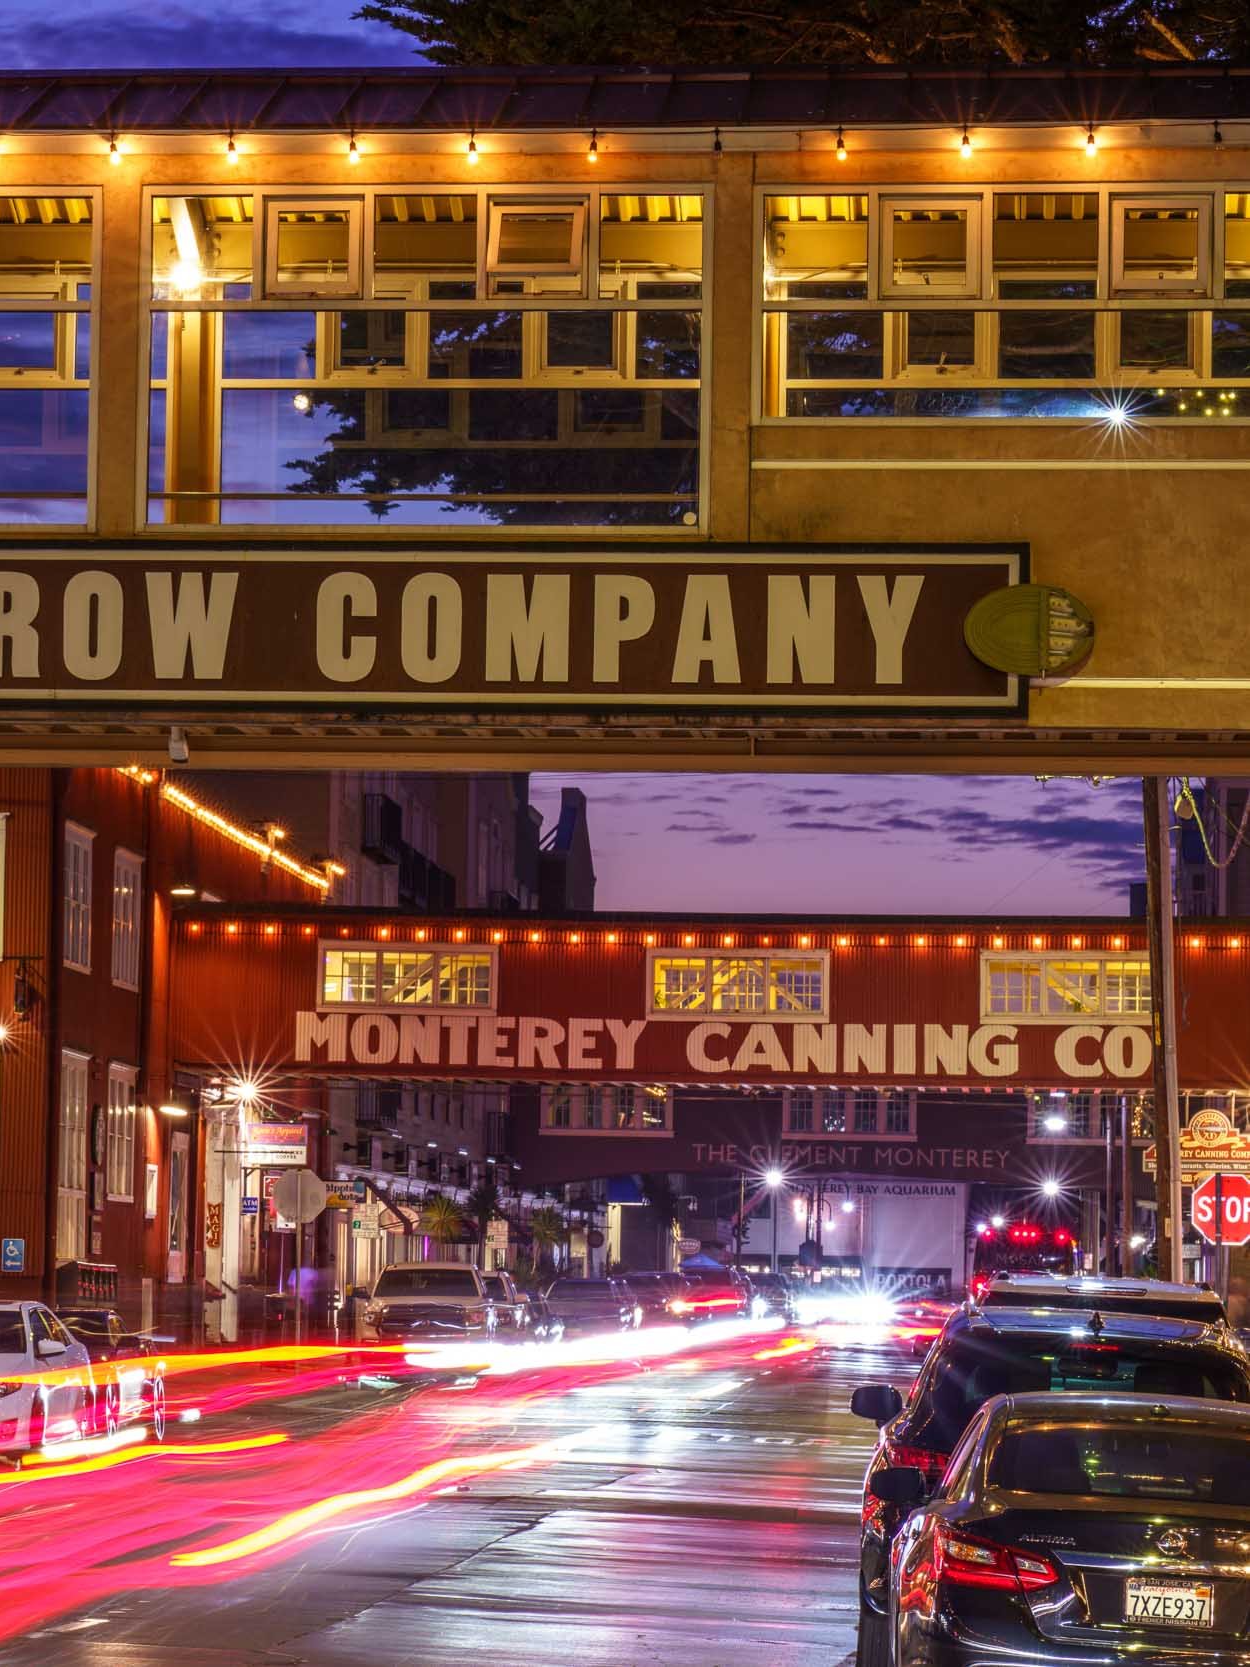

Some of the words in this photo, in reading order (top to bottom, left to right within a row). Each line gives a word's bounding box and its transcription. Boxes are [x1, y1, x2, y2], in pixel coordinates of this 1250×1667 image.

[317, 571, 925, 686] COMPANY
[295, 1011, 648, 1070] MONTEREY
[686, 1023, 1020, 1077] CANNING
[1054, 1025, 1152, 1078] CO
[692, 1144, 738, 1164] THE
[751, 1145, 863, 1166] CLEMENT
[875, 1148, 1010, 1169] MONTEREY
[1195, 1149, 1229, 1158] CANNING
[856, 1184, 879, 1195] BAY
[883, 1185, 956, 1196] AQUARIUM
[243, 1200, 258, 1208] ATM
[208, 1206, 221, 1247] MAGIC
[877, 1274, 946, 1289] PORTOLA
[1018, 1533, 1077, 1546] ALTIMA
[1129, 1594, 1206, 1621] 7XZE937
